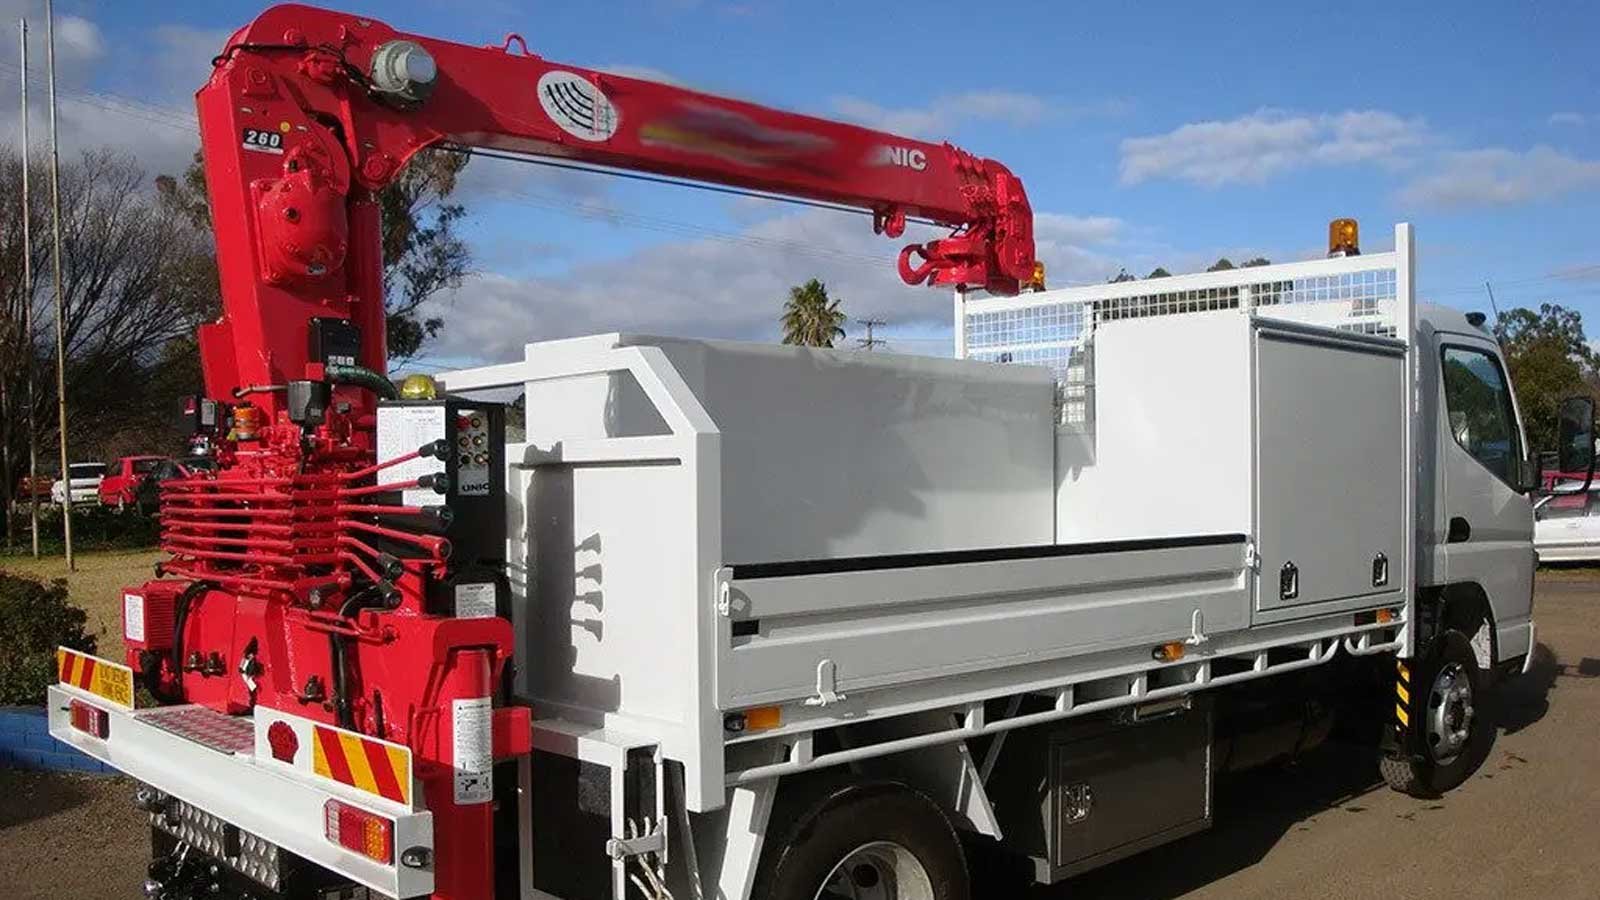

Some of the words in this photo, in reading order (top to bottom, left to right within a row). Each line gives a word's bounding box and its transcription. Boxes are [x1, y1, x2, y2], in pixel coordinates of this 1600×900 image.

[246, 130, 280, 147] 260
[875, 145, 926, 171] NIC
[462, 483, 490, 492] UNIC
